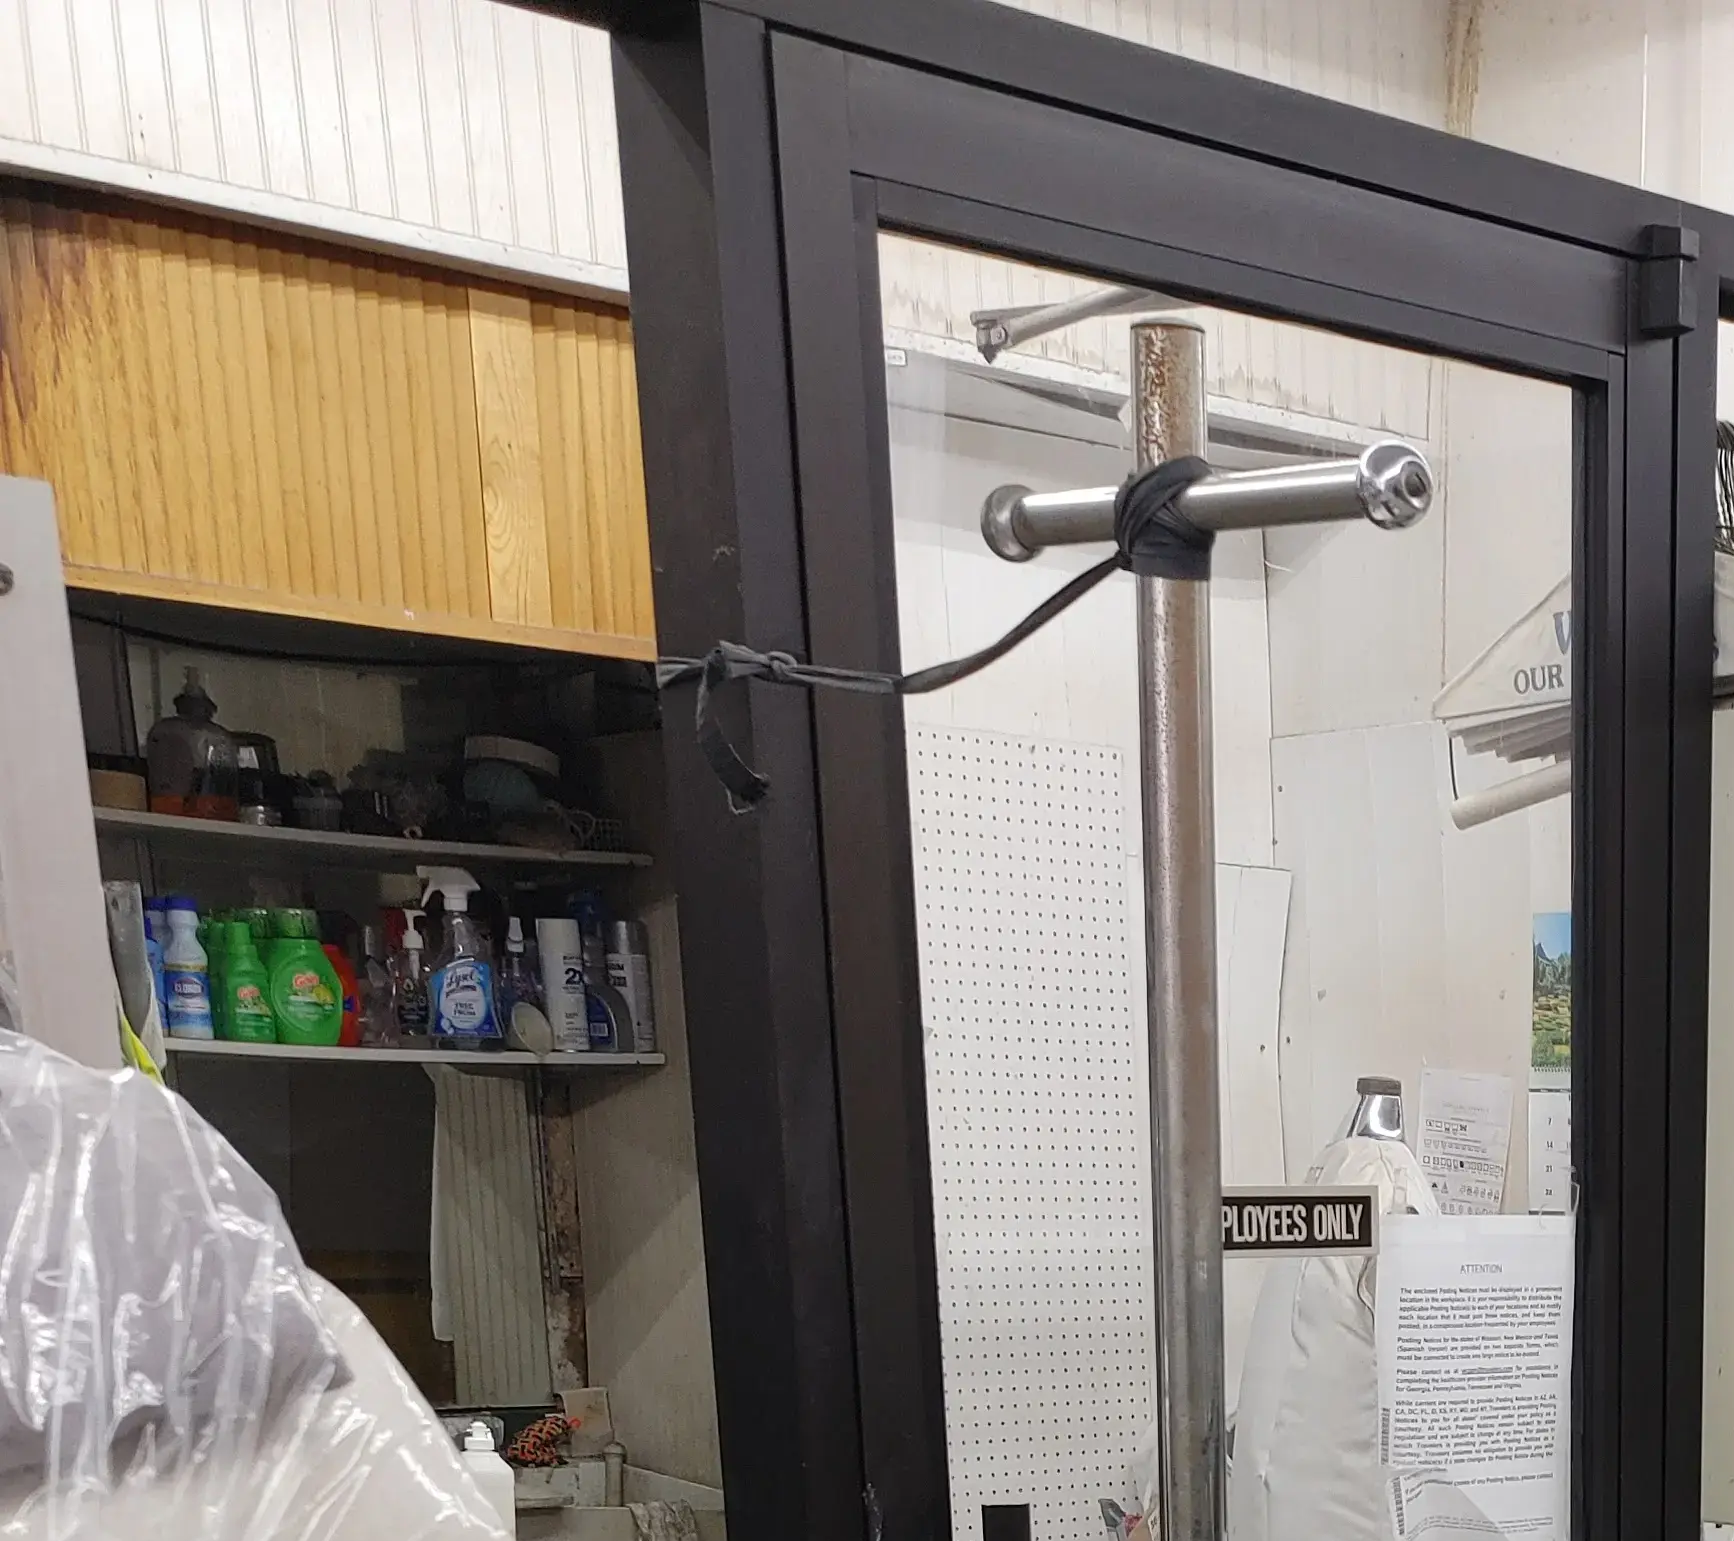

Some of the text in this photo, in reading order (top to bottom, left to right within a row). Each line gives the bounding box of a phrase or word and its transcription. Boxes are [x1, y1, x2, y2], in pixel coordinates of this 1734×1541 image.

[1514, 664, 1565, 694] OUR
[1221, 1204, 1364, 1243] PLOYEES ONLY
[1460, 1264, 1503, 1275] ATTENTION
